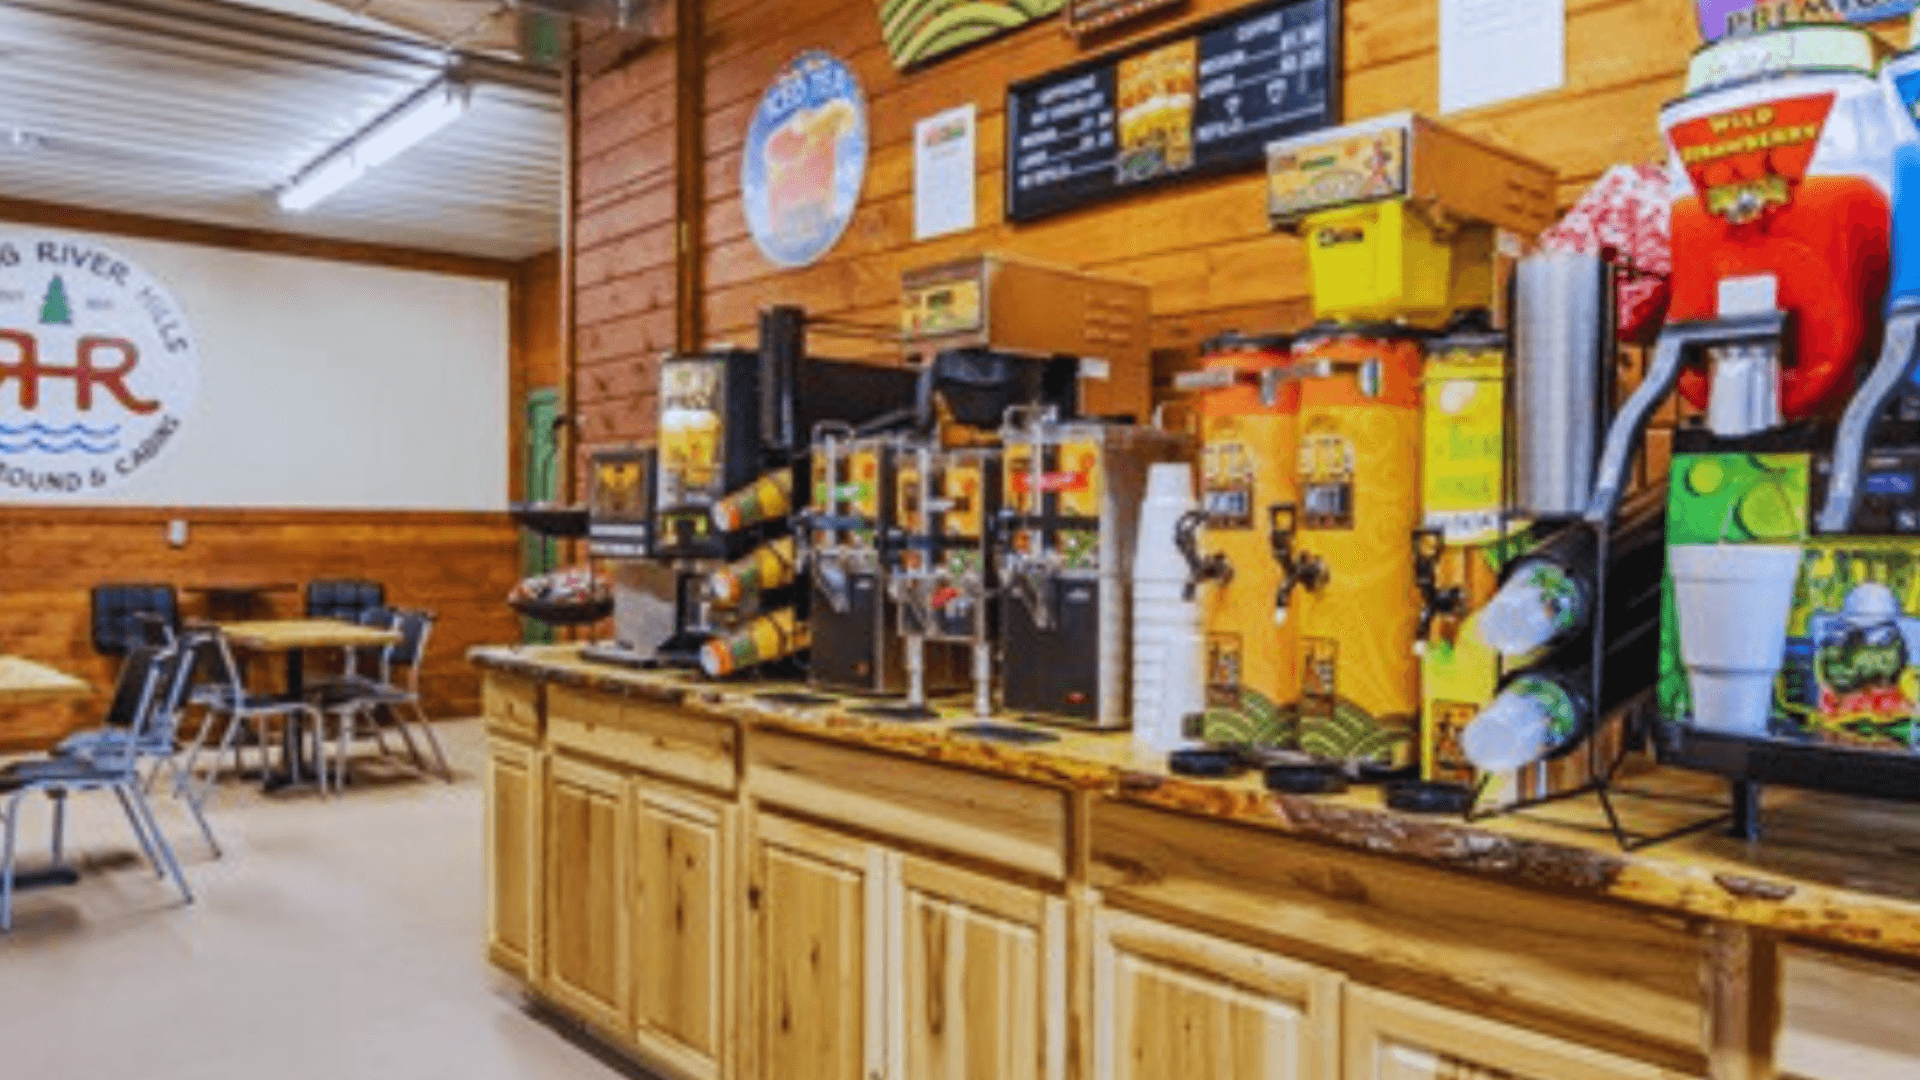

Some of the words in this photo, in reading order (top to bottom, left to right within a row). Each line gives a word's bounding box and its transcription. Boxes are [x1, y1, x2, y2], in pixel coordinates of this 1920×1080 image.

[1710, 105, 1775, 136] WILD
[1682, 124, 1817, 162] STRAWBERRY
[36, 240, 131, 288] RIVER
[135, 285, 190, 354] HILLS
